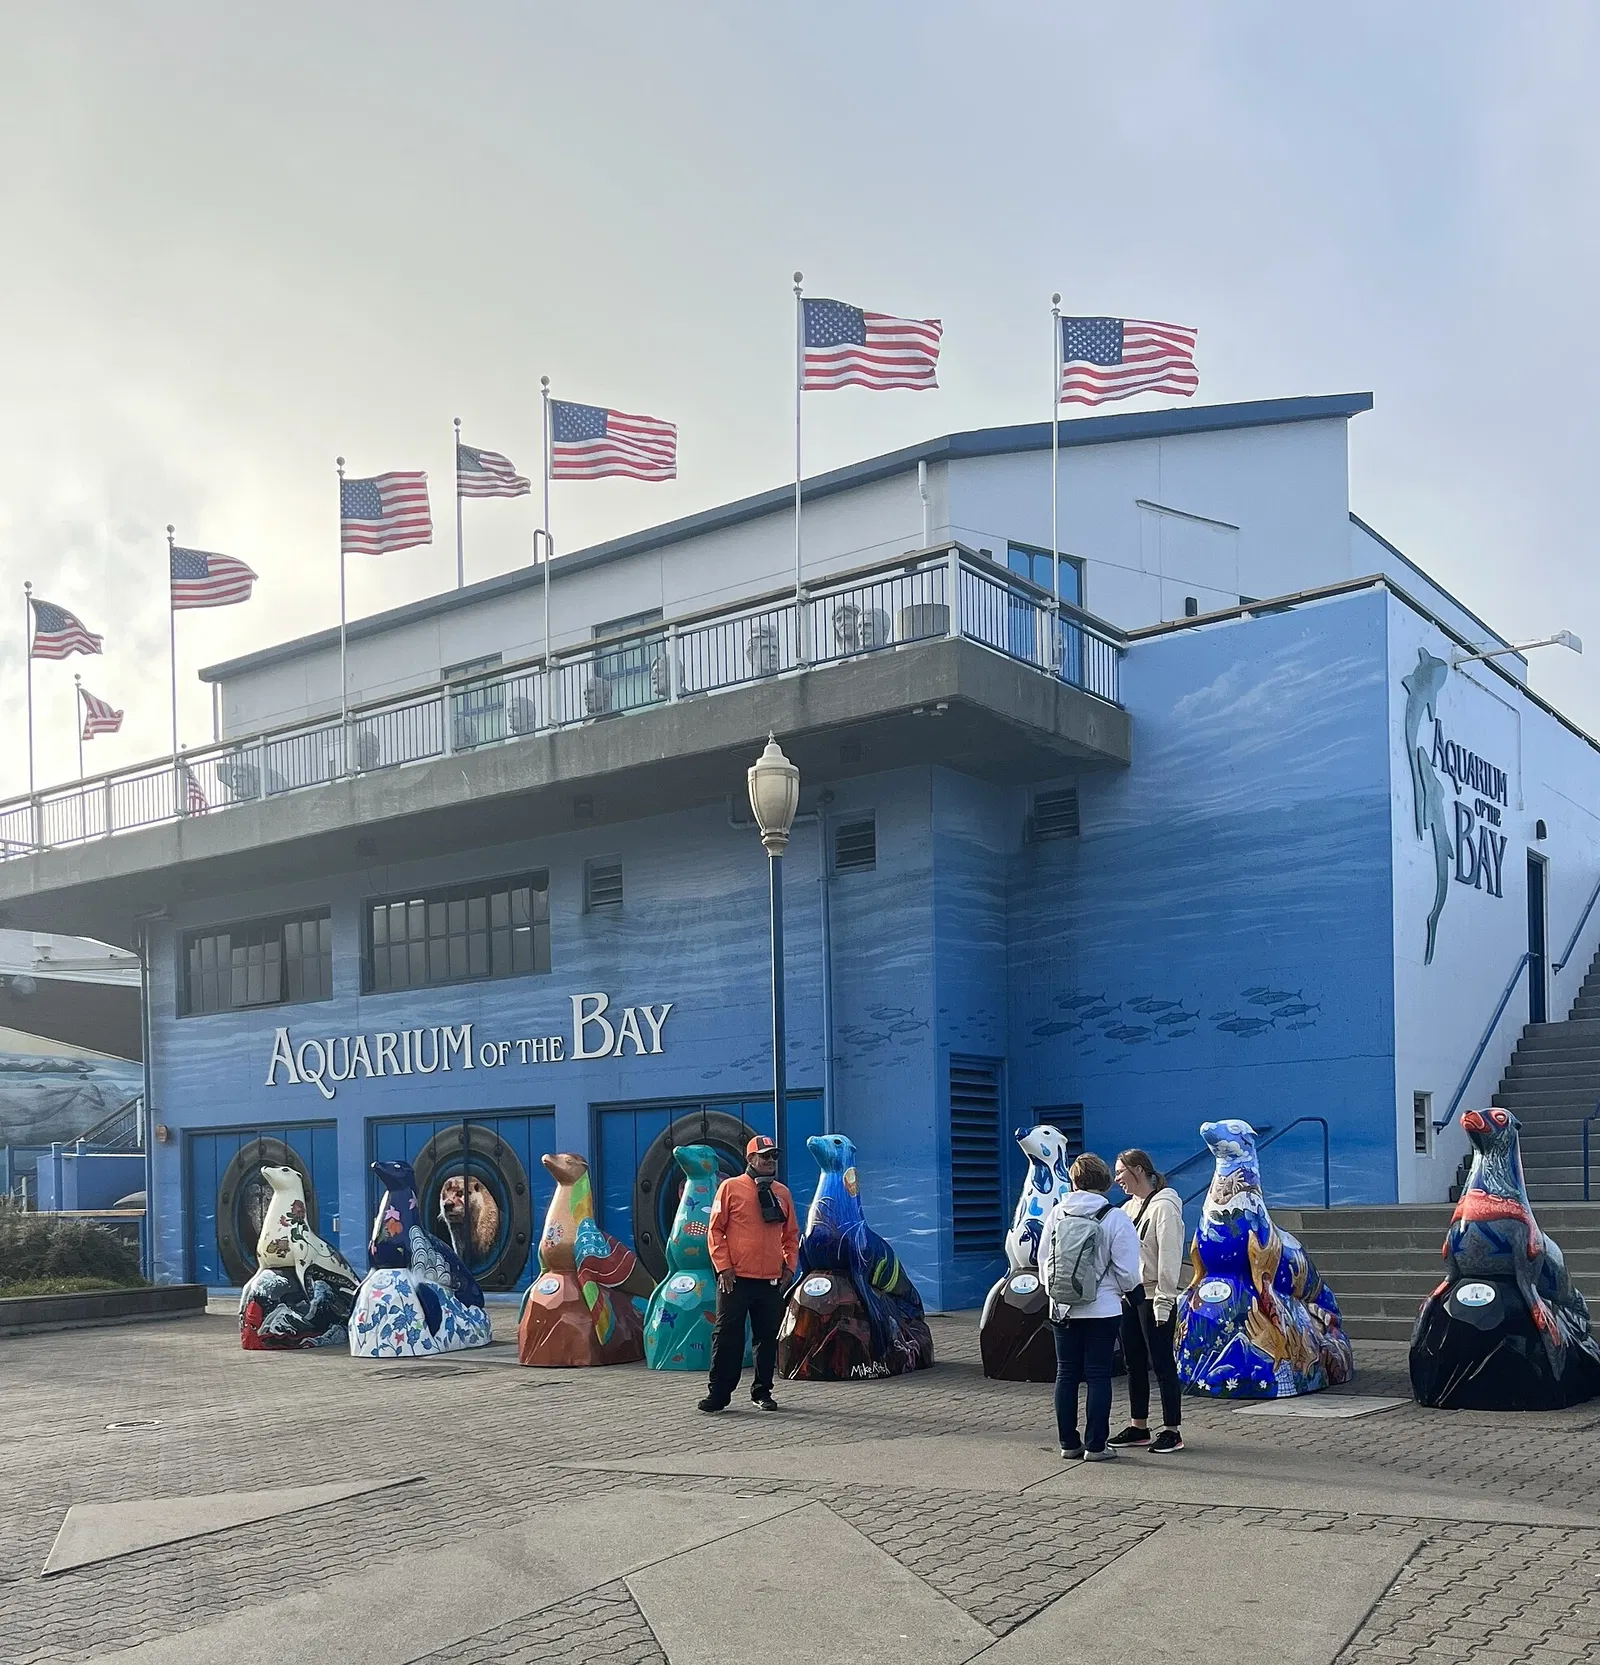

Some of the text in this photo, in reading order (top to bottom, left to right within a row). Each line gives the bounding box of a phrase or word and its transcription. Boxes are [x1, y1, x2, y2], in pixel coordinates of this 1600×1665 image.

[1432, 718, 1508, 806] AQUARIUM
[1455, 801, 1507, 898] BAY
[1475, 798, 1501, 827] OF THE
[265, 992, 674, 1099] AQUARIUM OF THE BAY
